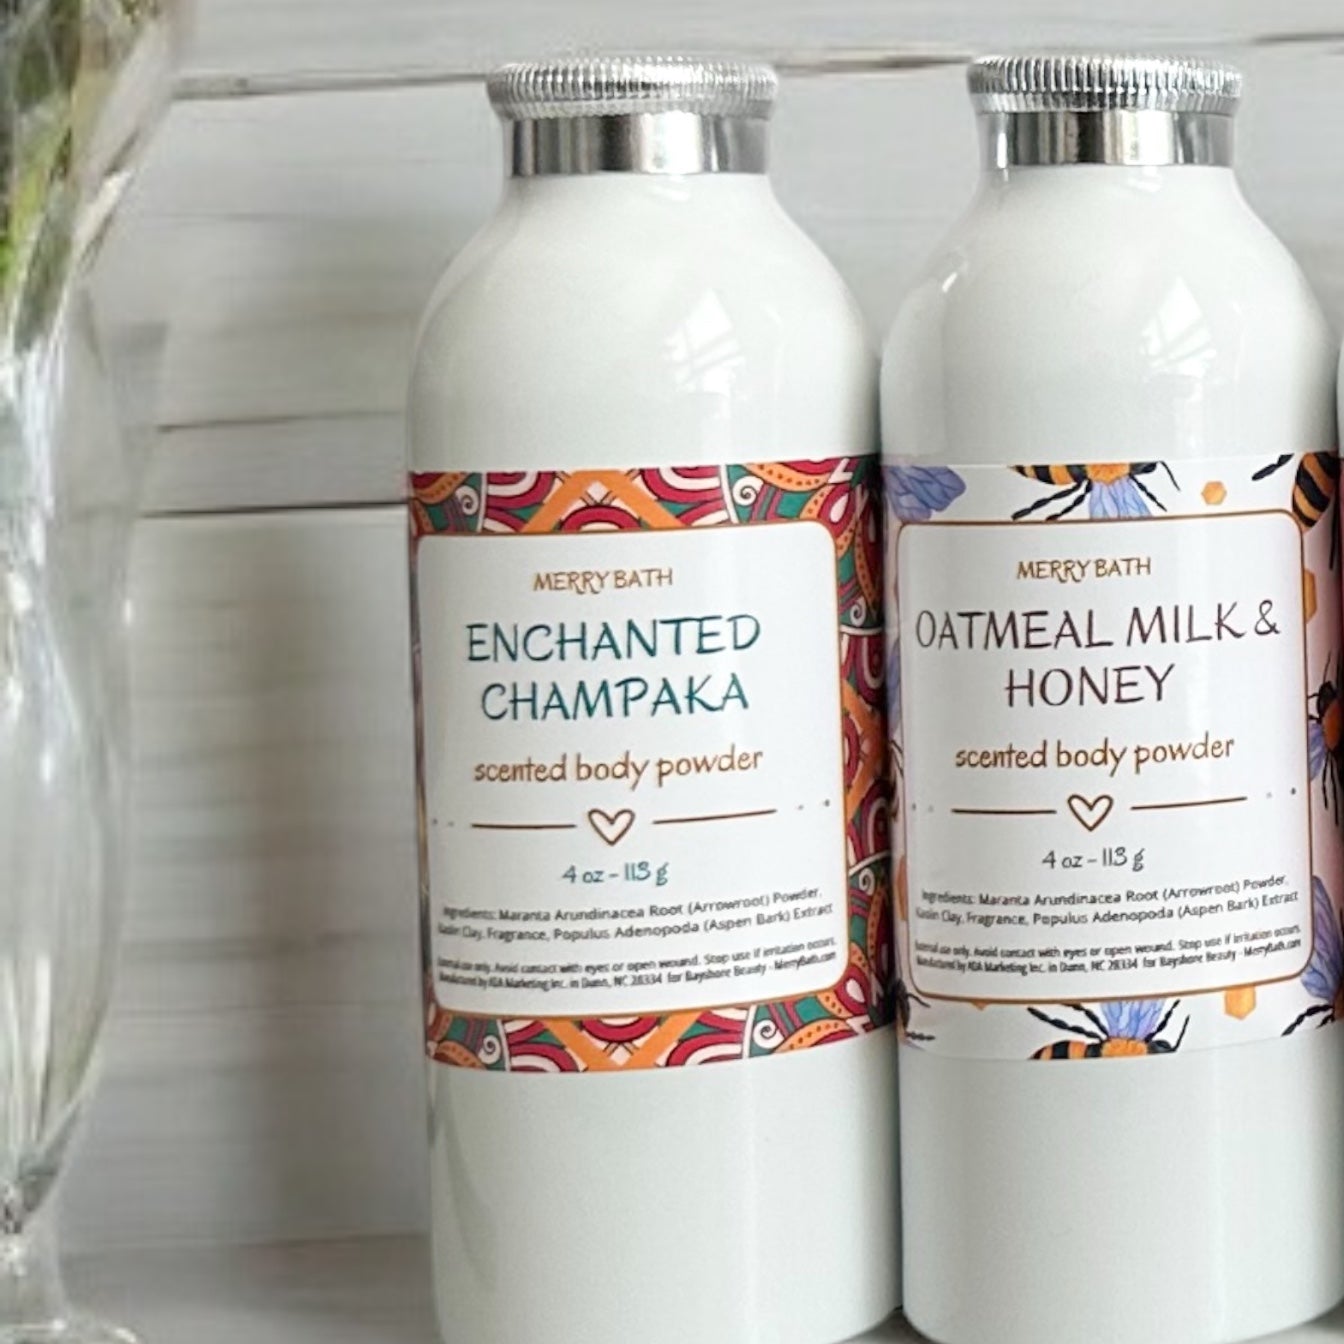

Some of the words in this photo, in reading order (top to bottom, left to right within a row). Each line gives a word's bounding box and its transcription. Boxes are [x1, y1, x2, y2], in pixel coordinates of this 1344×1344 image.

[533, 571, 610, 595] MERRY
[614, 568, 672, 589] BATH
[1017, 560, 1091, 583] MERRY
[1094, 557, 1151, 578] BATH
[466, 614, 760, 662] ENCHANTED
[916, 609, 1114, 650] OATMEAL
[1127, 602, 1245, 647] MILK
[1254, 599, 1280, 636] &
[482, 673, 748, 720] CHAMPAKA
[1005, 664, 1175, 707] HONEY
[474, 753, 567, 783] scented
[576, 750, 650, 791] body
[656, 744, 763, 788] powder
[956, 740, 1047, 769] scented
[1056, 737, 1127, 777] body
[1134, 731, 1234, 774] powder
[562, 865, 577, 883] 4
[582, 870, 604, 884] oz
[624, 862, 651, 881] 113
[655, 862, 669, 886] g
[1042, 850, 1056, 869] 4
[1061, 856, 1083, 868] oz
[1103, 848, 1127, 866] 113
[1132, 848, 1145, 872] g
